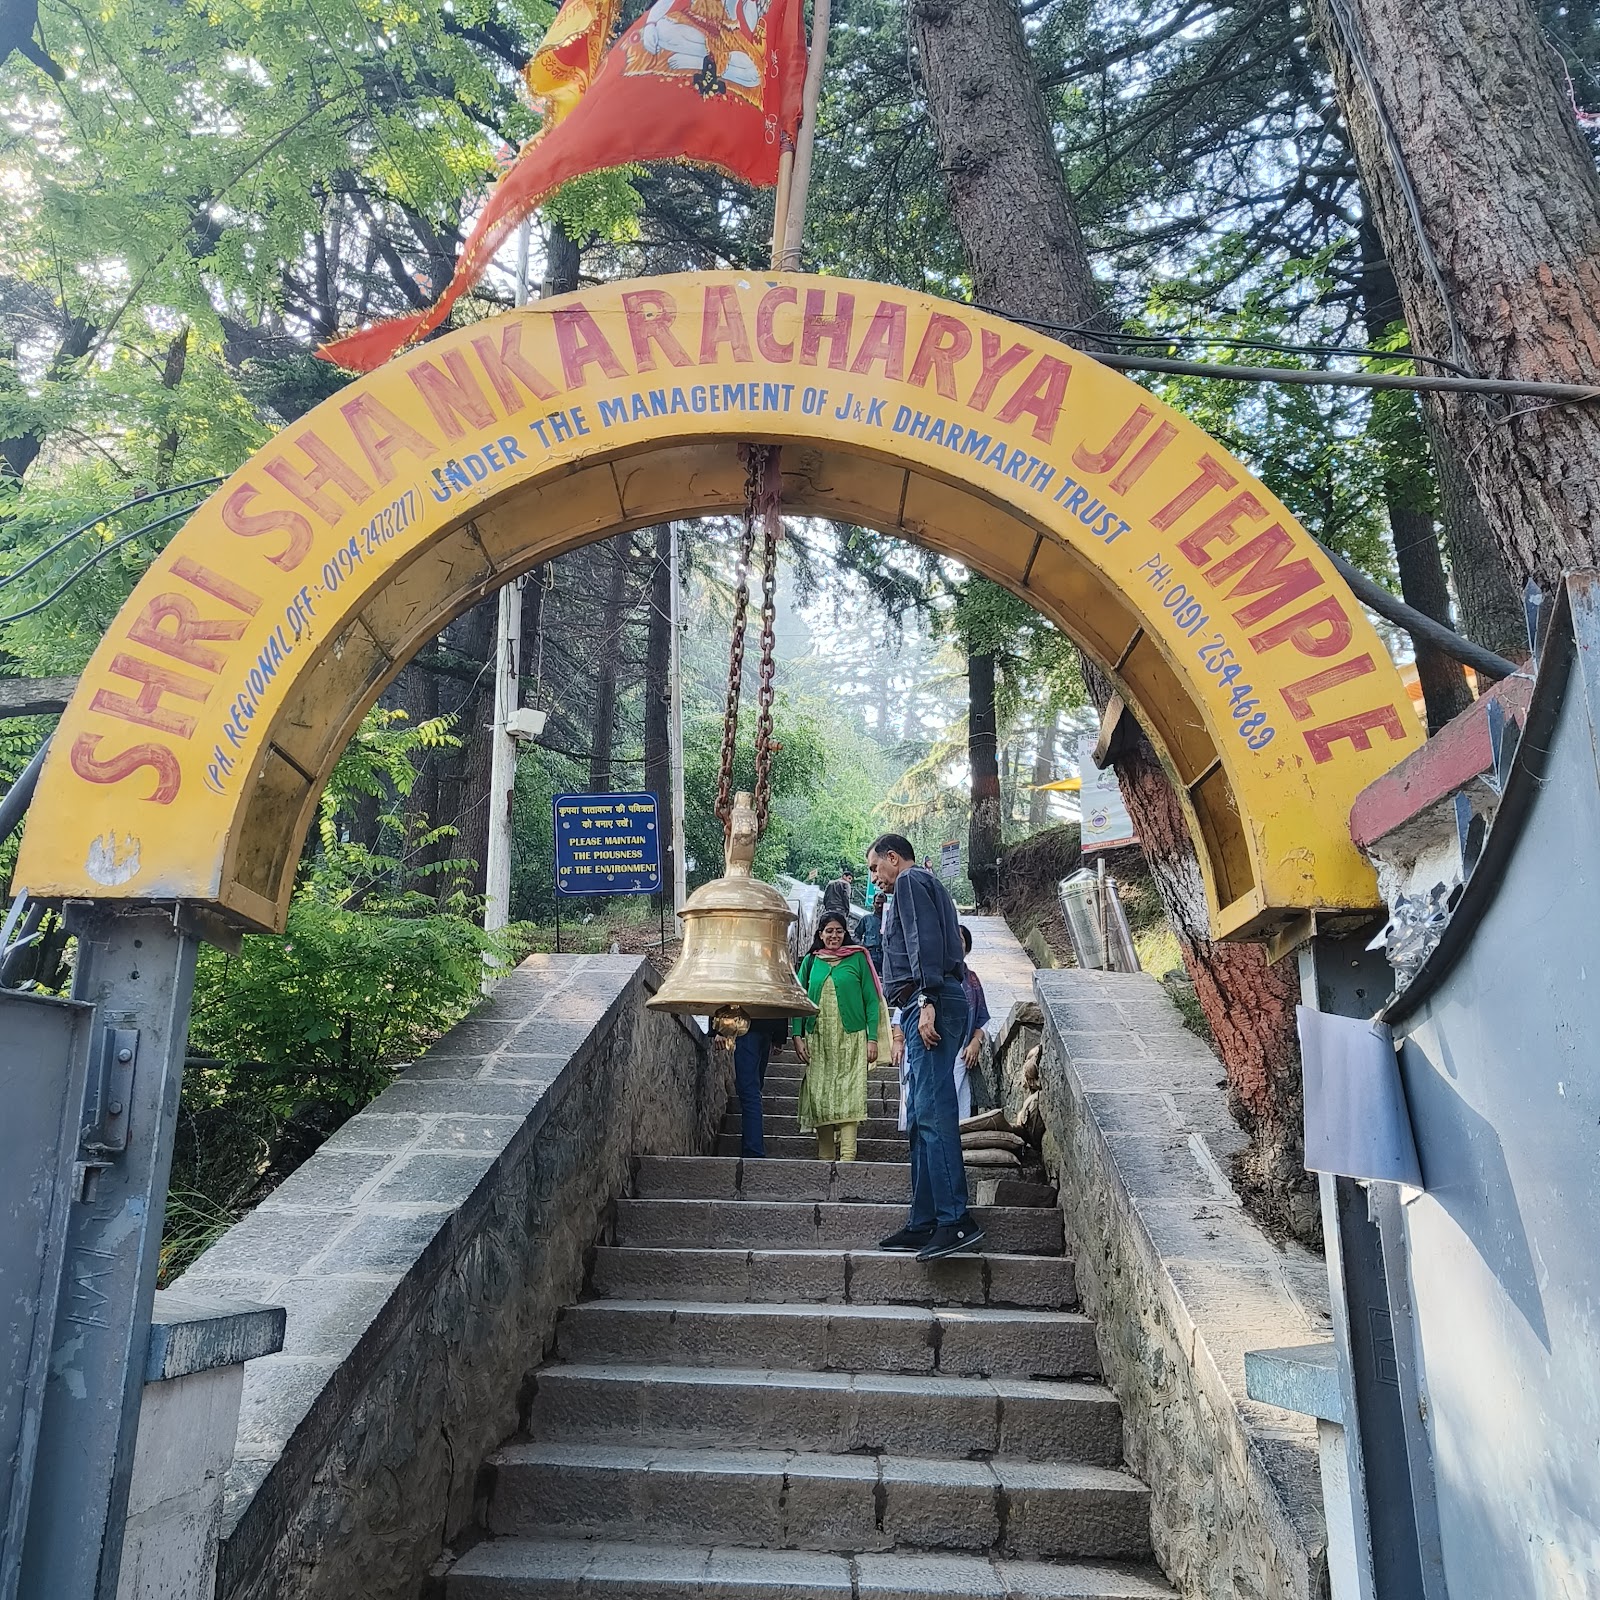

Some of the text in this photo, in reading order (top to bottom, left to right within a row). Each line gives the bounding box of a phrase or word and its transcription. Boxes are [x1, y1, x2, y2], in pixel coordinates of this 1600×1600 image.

[70, 284, 1407, 805] SHRI SHANKARACHARYA JI TEMPLE
[223, 625, 293, 749] REGIONAL
[429, 434, 528, 503] UNDER
[529, 405, 591, 450] THE
[597, 383, 796, 428] MANAGEMENT
[801, 387, 829, 416] OF
[834, 393, 889, 427] J&K
[891, 405, 1058, 493] DHARMARTH
[1053, 476, 1132, 546] TRUST
[569, 836, 646, 847] PLEASE MAINTAIN
[573, 849, 643, 860] THE PIOUSNESS
[560, 863, 657, 875] OF THE ENVIRONMENT
